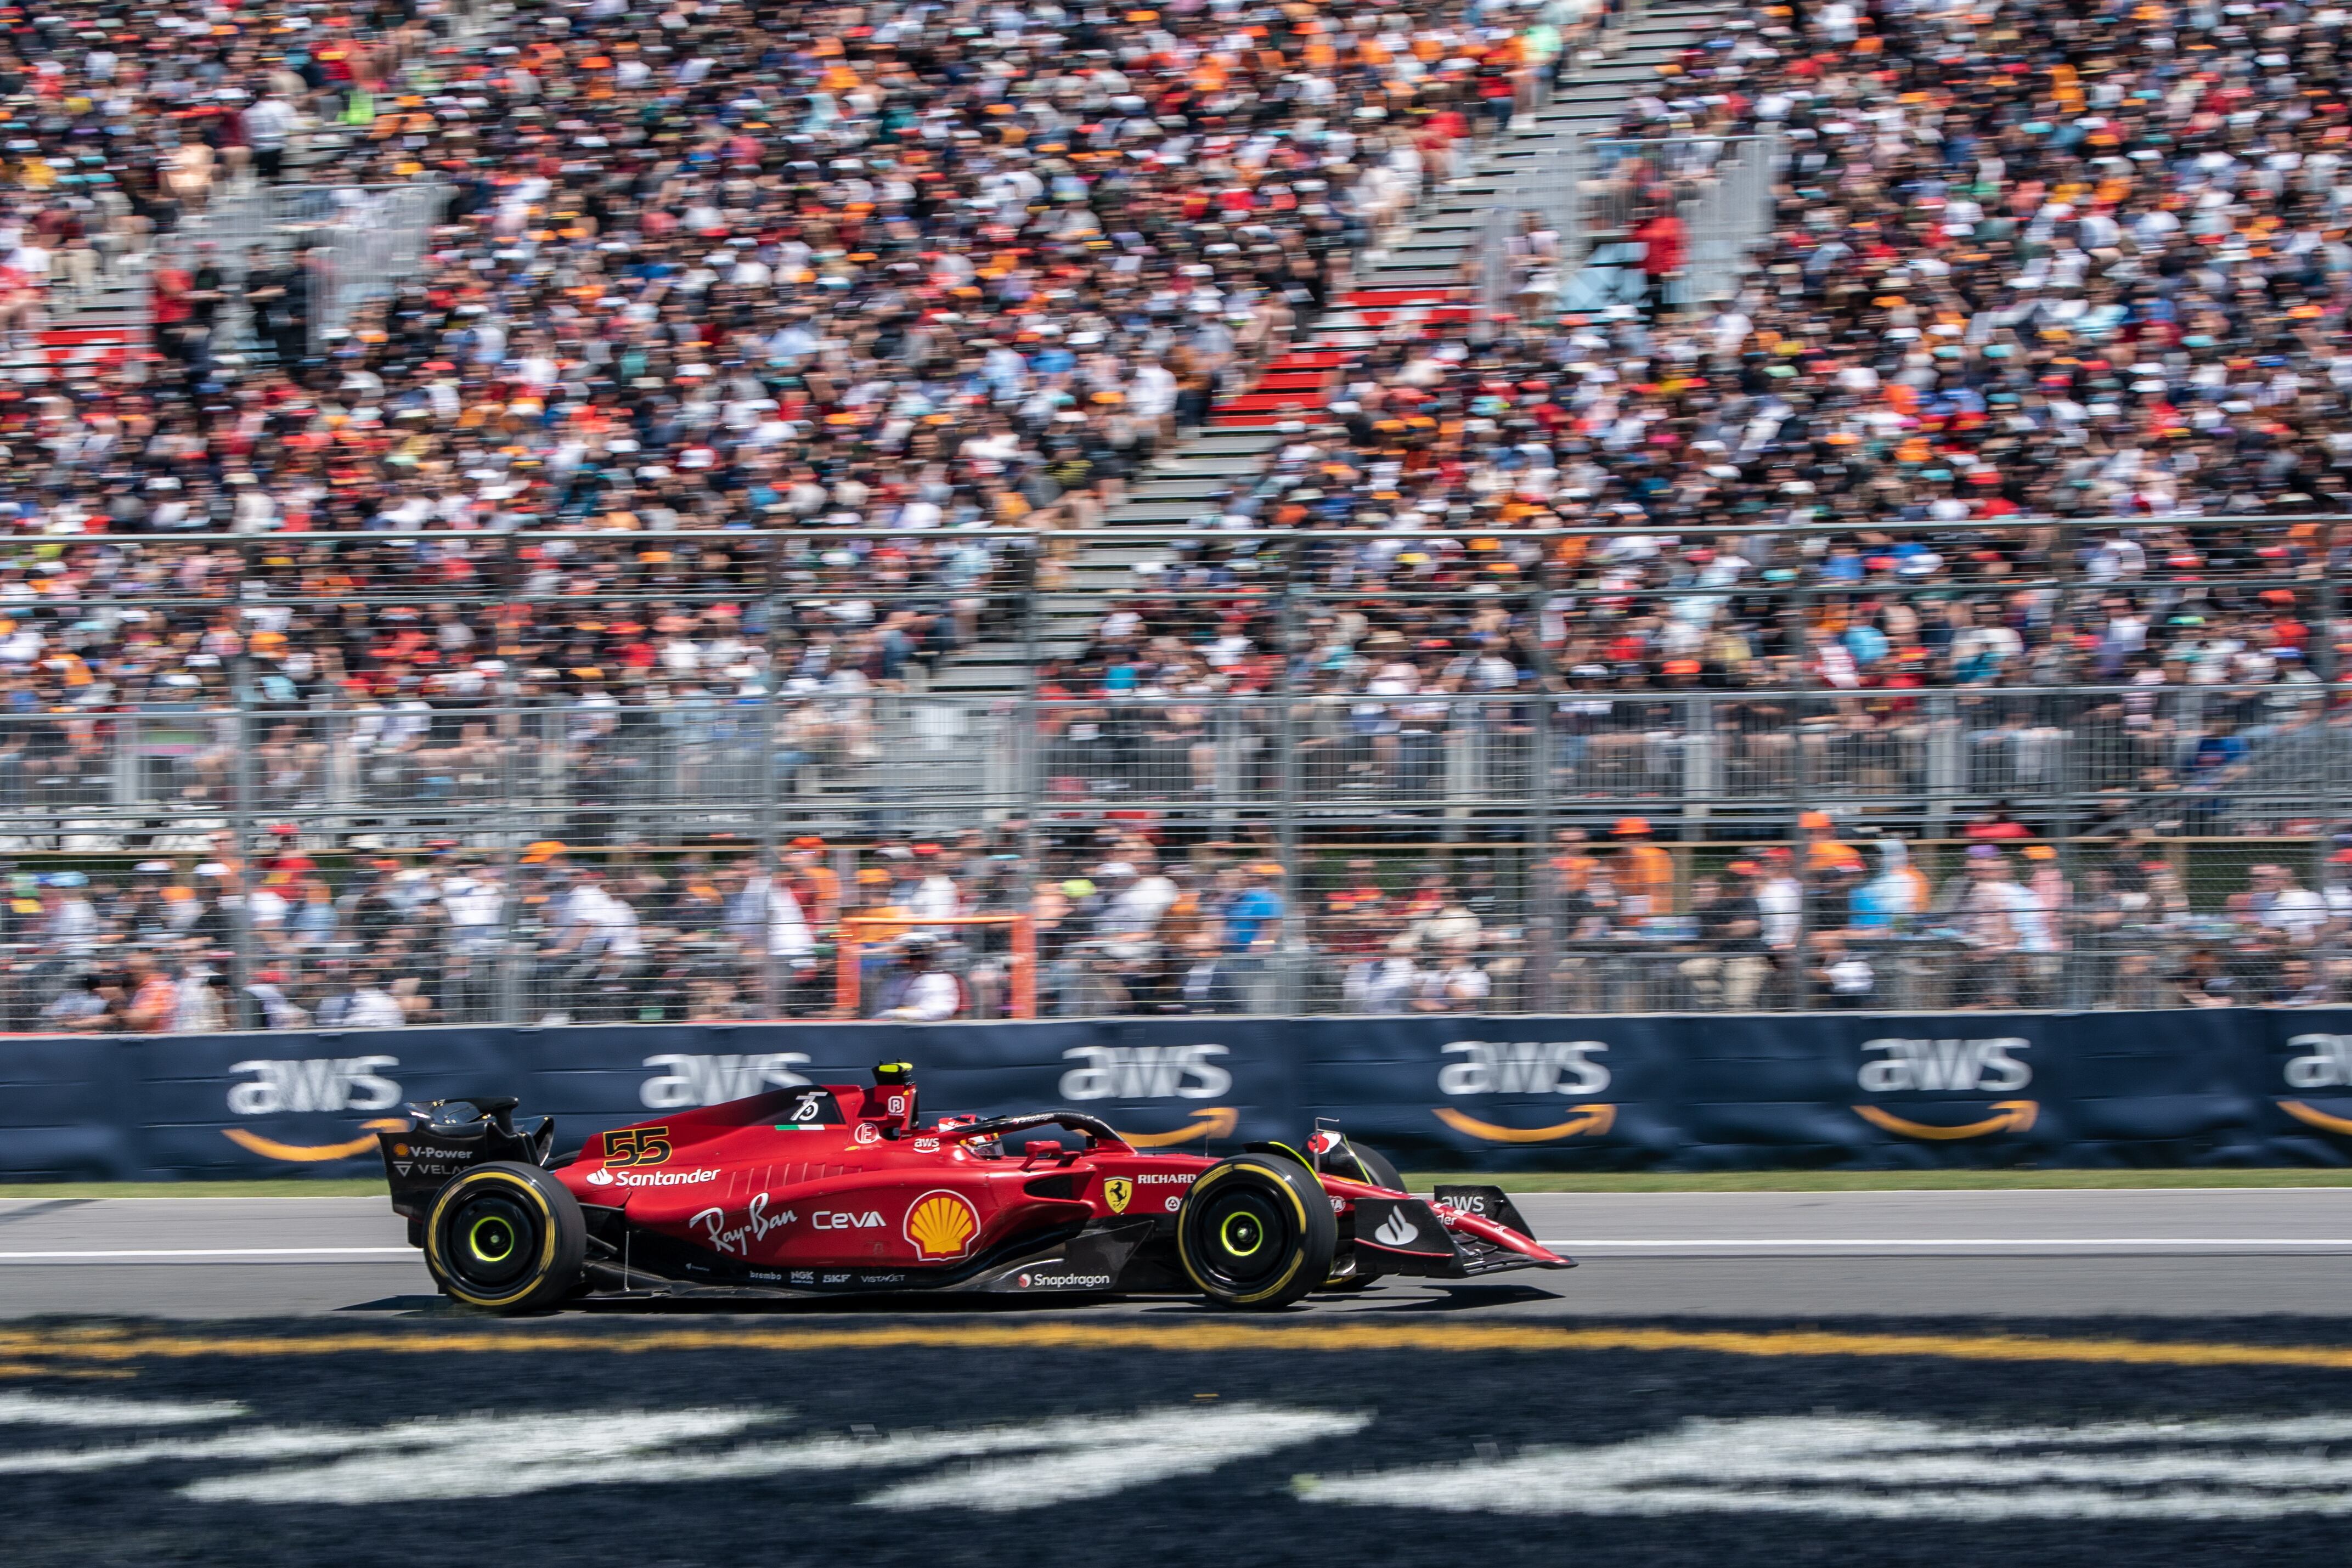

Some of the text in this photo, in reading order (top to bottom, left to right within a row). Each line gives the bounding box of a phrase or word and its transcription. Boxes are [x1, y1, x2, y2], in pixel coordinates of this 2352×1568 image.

[1058, 1044, 1233, 1100] aws
[1437, 1041, 1611, 1095] aws
[1857, 1037, 2033, 1092] aws
[227, 1055, 403, 1115] aws
[603, 1126, 673, 1167] 55
[914, 1138, 939, 1147] aws
[410, 1146, 473, 1159] V-Power
[615, 1169, 721, 1186] Santander
[1137, 1174, 1197, 1184] RICHARD
[1441, 1196, 1485, 1212] aws
[749, 1271, 782, 1280] brembo
[791, 1271, 814, 1279] NGK
[822, 1274, 850, 1283] SKF
[1034, 1273, 1110, 1288] Snapdragon
